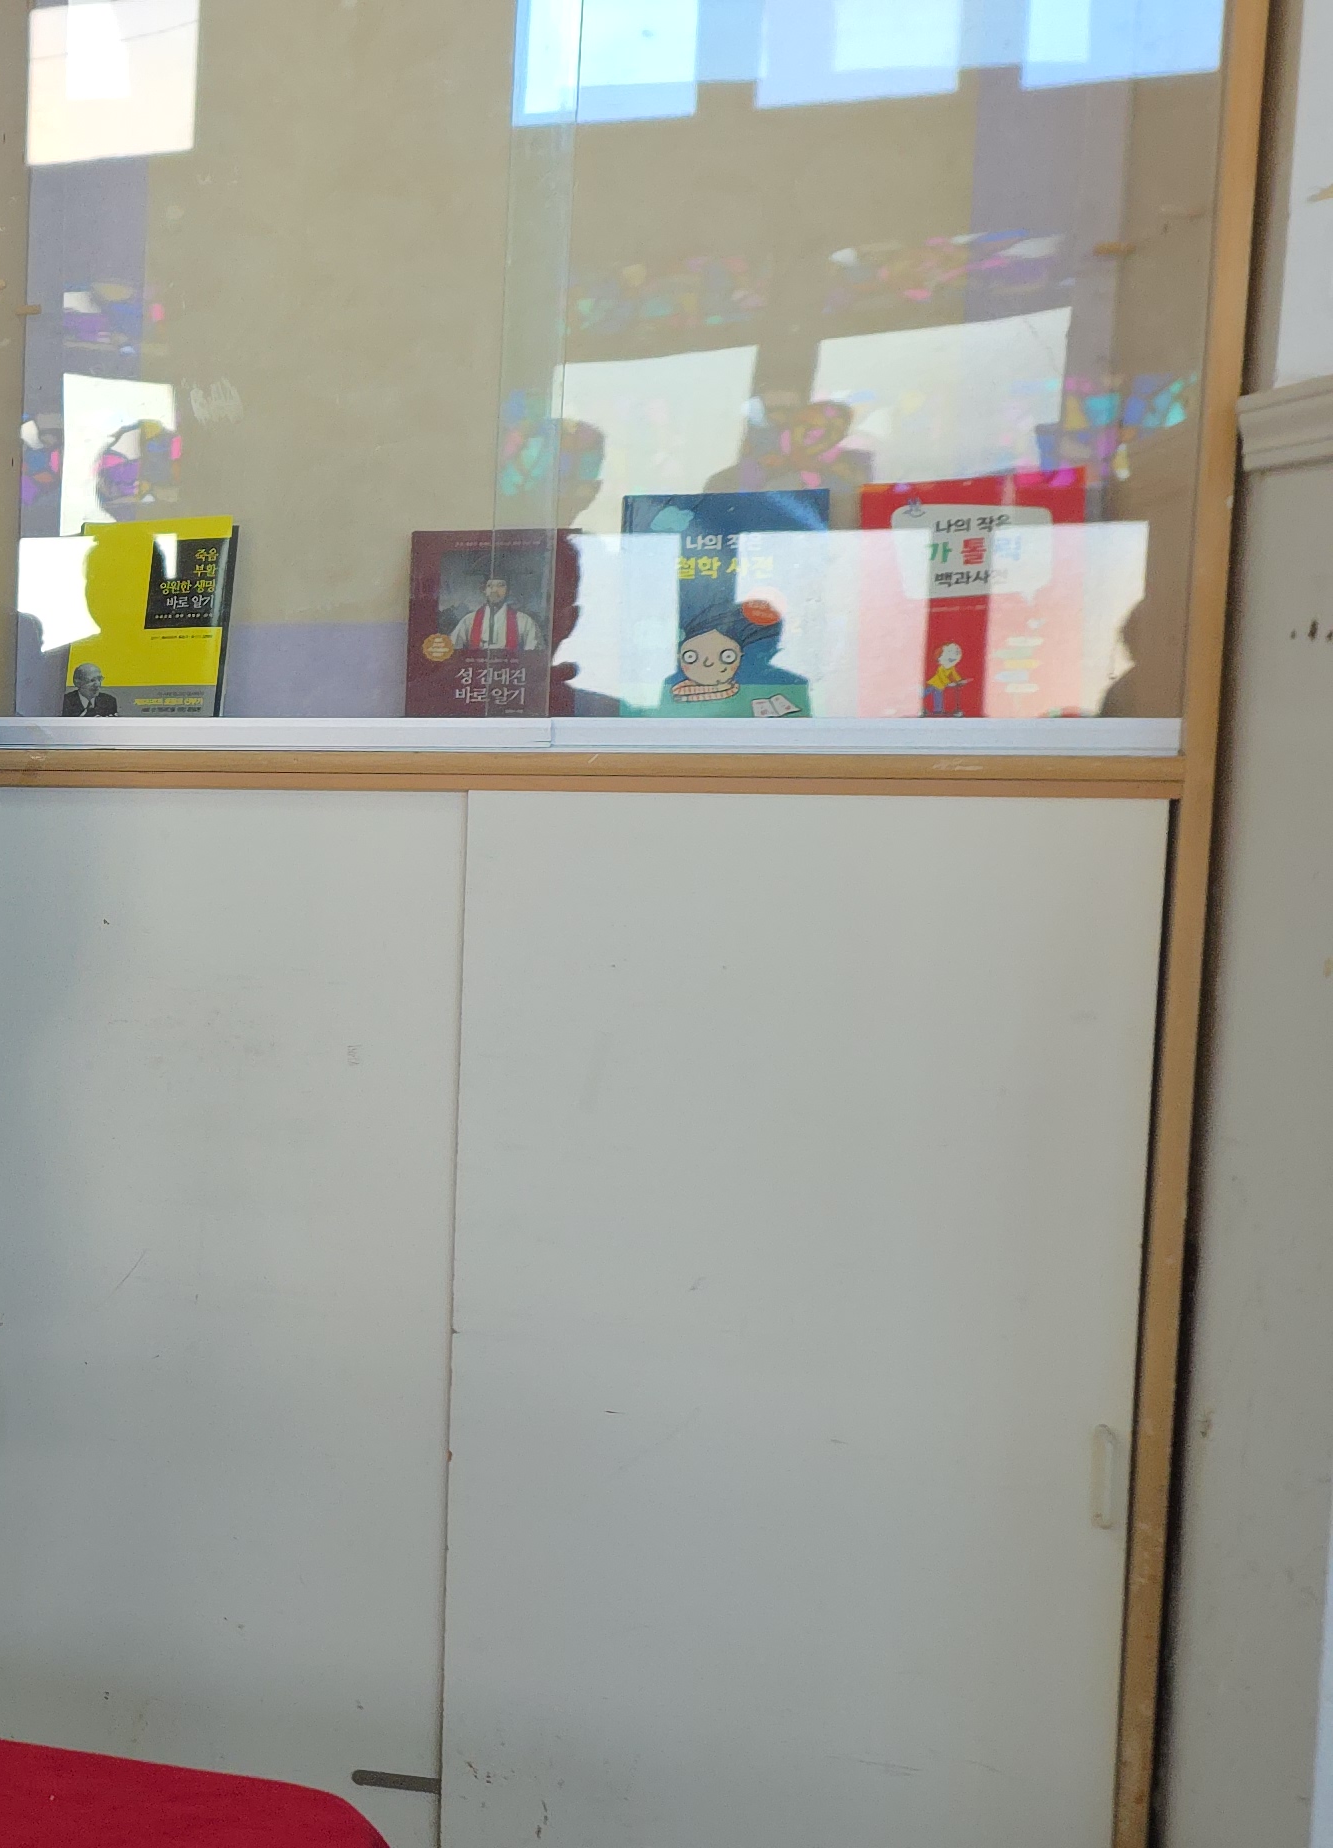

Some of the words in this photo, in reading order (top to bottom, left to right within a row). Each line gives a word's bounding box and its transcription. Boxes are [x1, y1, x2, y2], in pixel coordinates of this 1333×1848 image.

[935, 517, 971, 533] 나의
[976, 514, 1011, 532] 작은
[686, 534, 723, 550] 나의
[195, 548, 219, 561] 죽음
[194, 579, 216, 593] 생명
[166, 595, 190, 610] 바로
[192, 595, 214, 609] 알기
[455, 667, 473, 685] 성
[476, 667, 526, 685] 김대건
[455, 686, 490, 704] 바로
[491, 687, 525, 705] 알기
